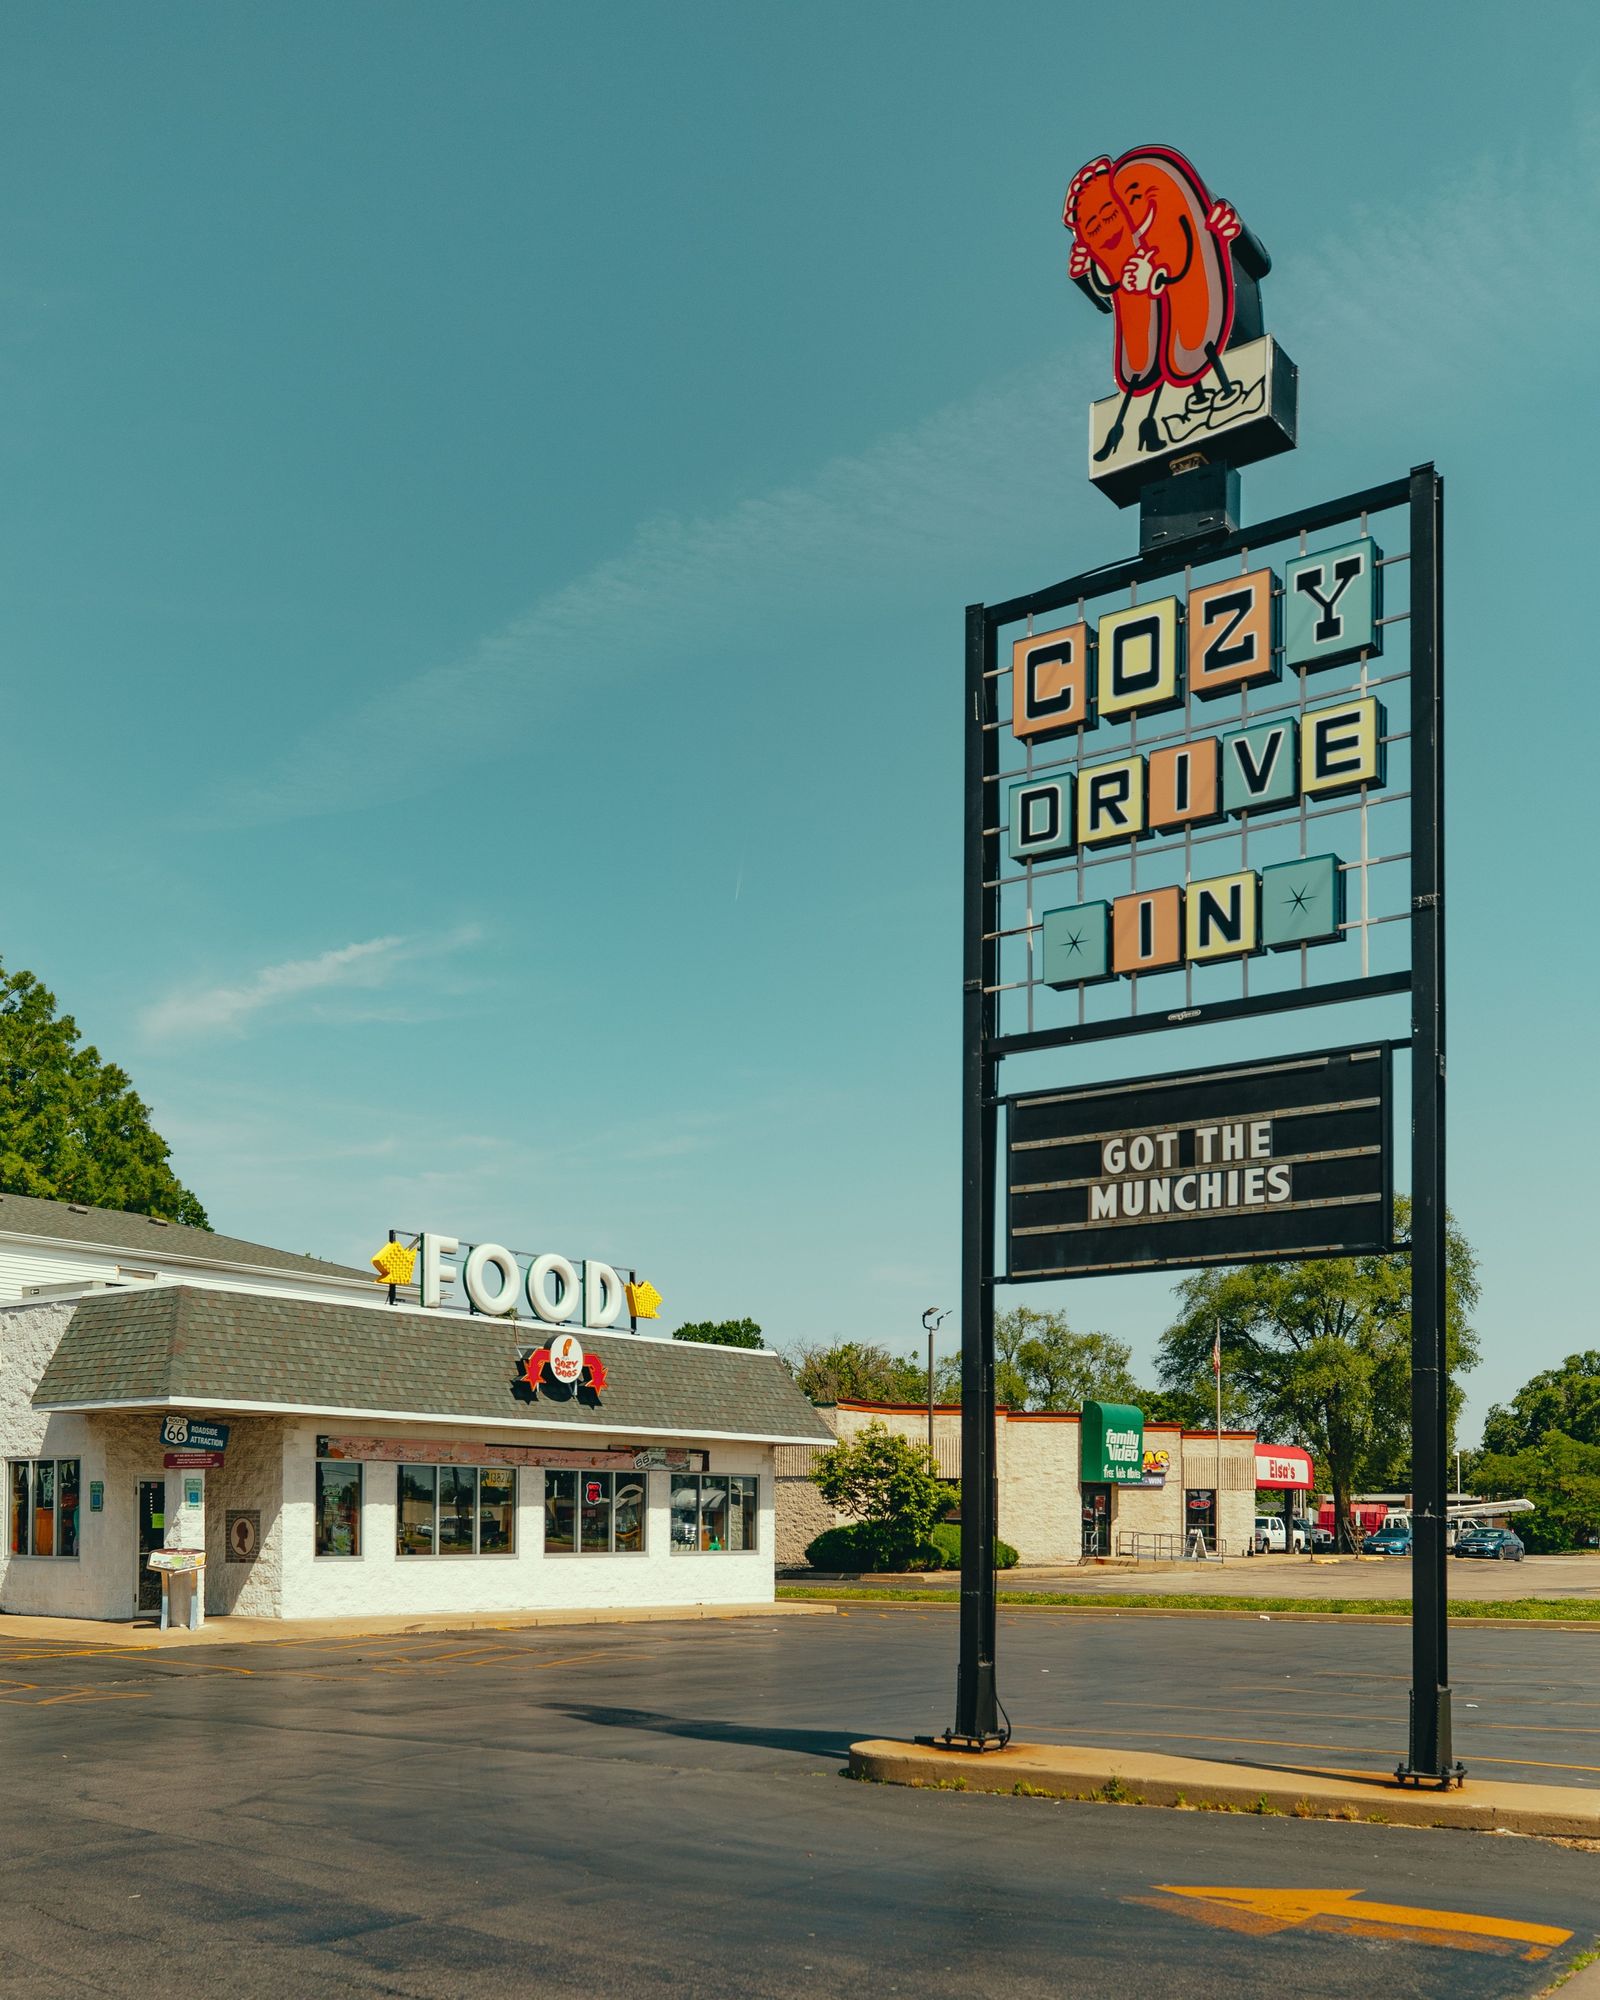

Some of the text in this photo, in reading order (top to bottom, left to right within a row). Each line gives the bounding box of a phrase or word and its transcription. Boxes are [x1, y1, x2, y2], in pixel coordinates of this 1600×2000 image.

[1025, 553, 1363, 719] COZY
[1018, 709, 1363, 848] DRIVE
[1138, 881, 1243, 960] IN
[1102, 1120, 1272, 1175] GOT THE
[1090, 1164, 1291, 1220] MUNCHIES
[420, 1232, 622, 1328] FOOD
[168, 1417, 186, 1425] ROUTE
[191, 1425, 219, 1437] ROADSIDE
[167, 1425, 185, 1441] 66
[190, 1435, 224, 1448] ATTRACTION
[1106, 1444, 1139, 1462] Video
[1142, 1450, 1169, 1466] AS
[1269, 1459, 1296, 1480] Elsa's
